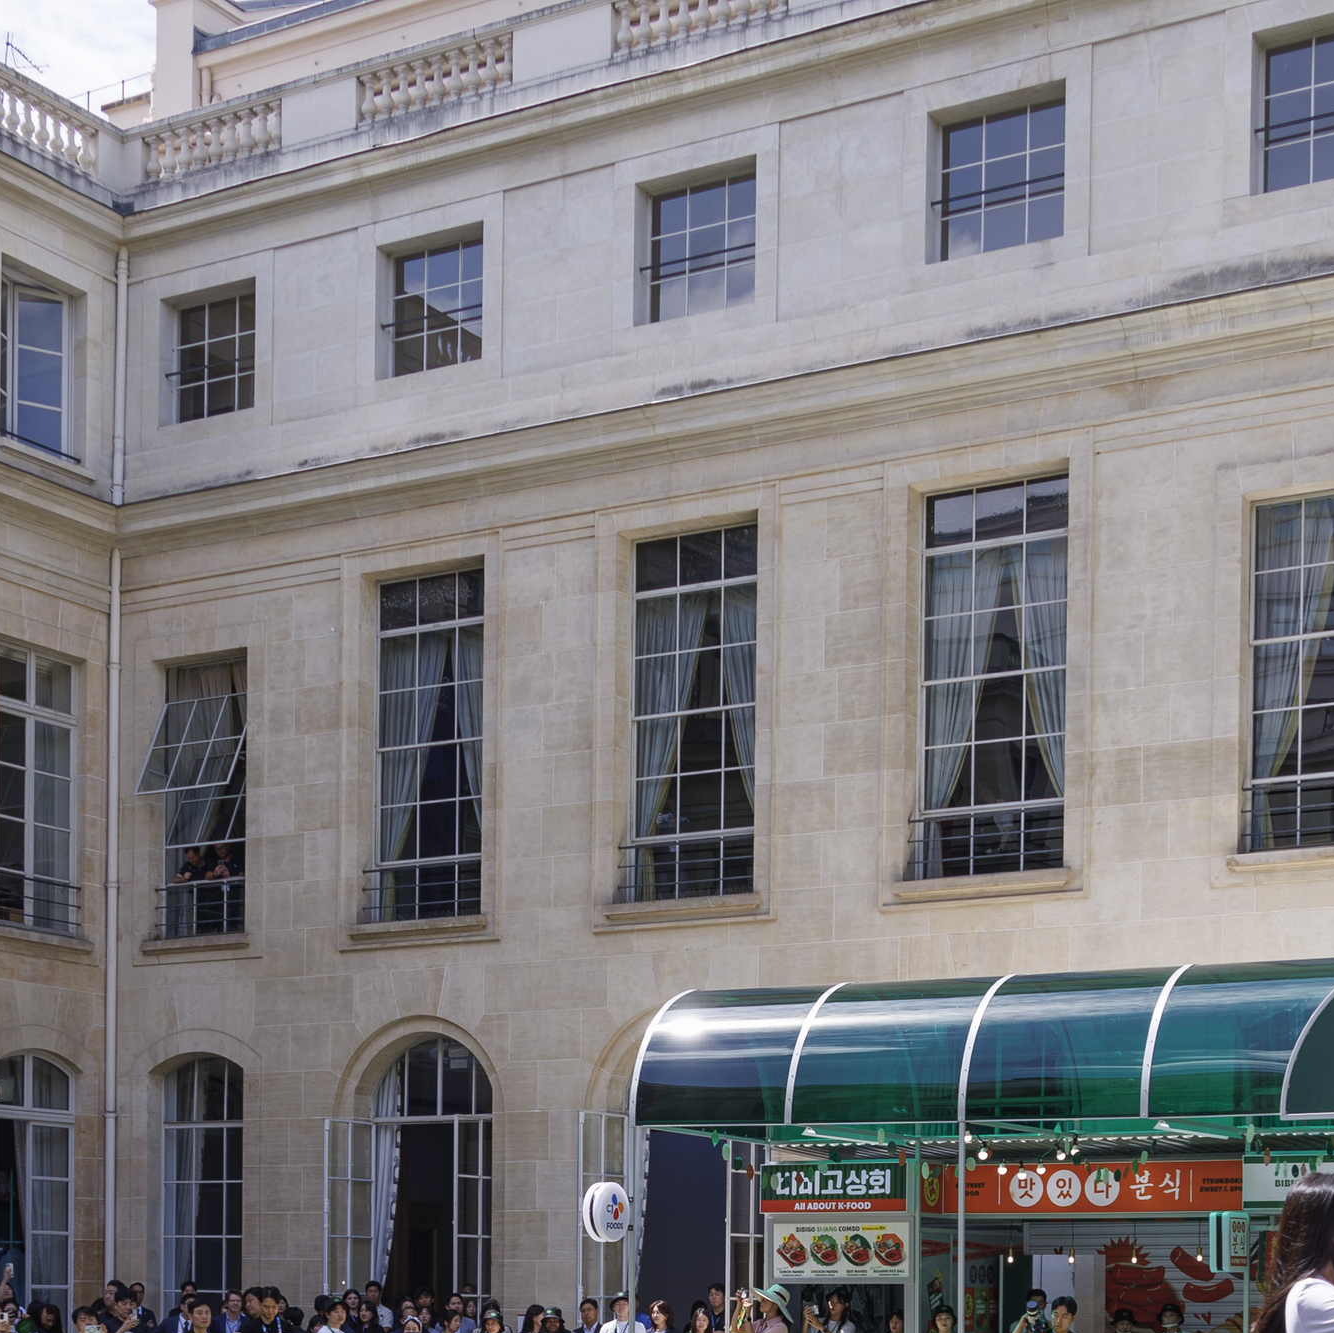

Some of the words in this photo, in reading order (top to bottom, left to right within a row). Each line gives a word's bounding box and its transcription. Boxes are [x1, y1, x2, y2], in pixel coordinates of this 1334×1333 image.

[775, 1168, 891, 1196] 비비고상회
[1129, 1169, 1182, 1201] 분식
[606, 1204, 614, 1215] CJ
[807, 1202, 836, 1210] ABOUT
[838, 1202, 872, 1210] K-FOOD
[606, 1222, 624, 1231] FOODS
